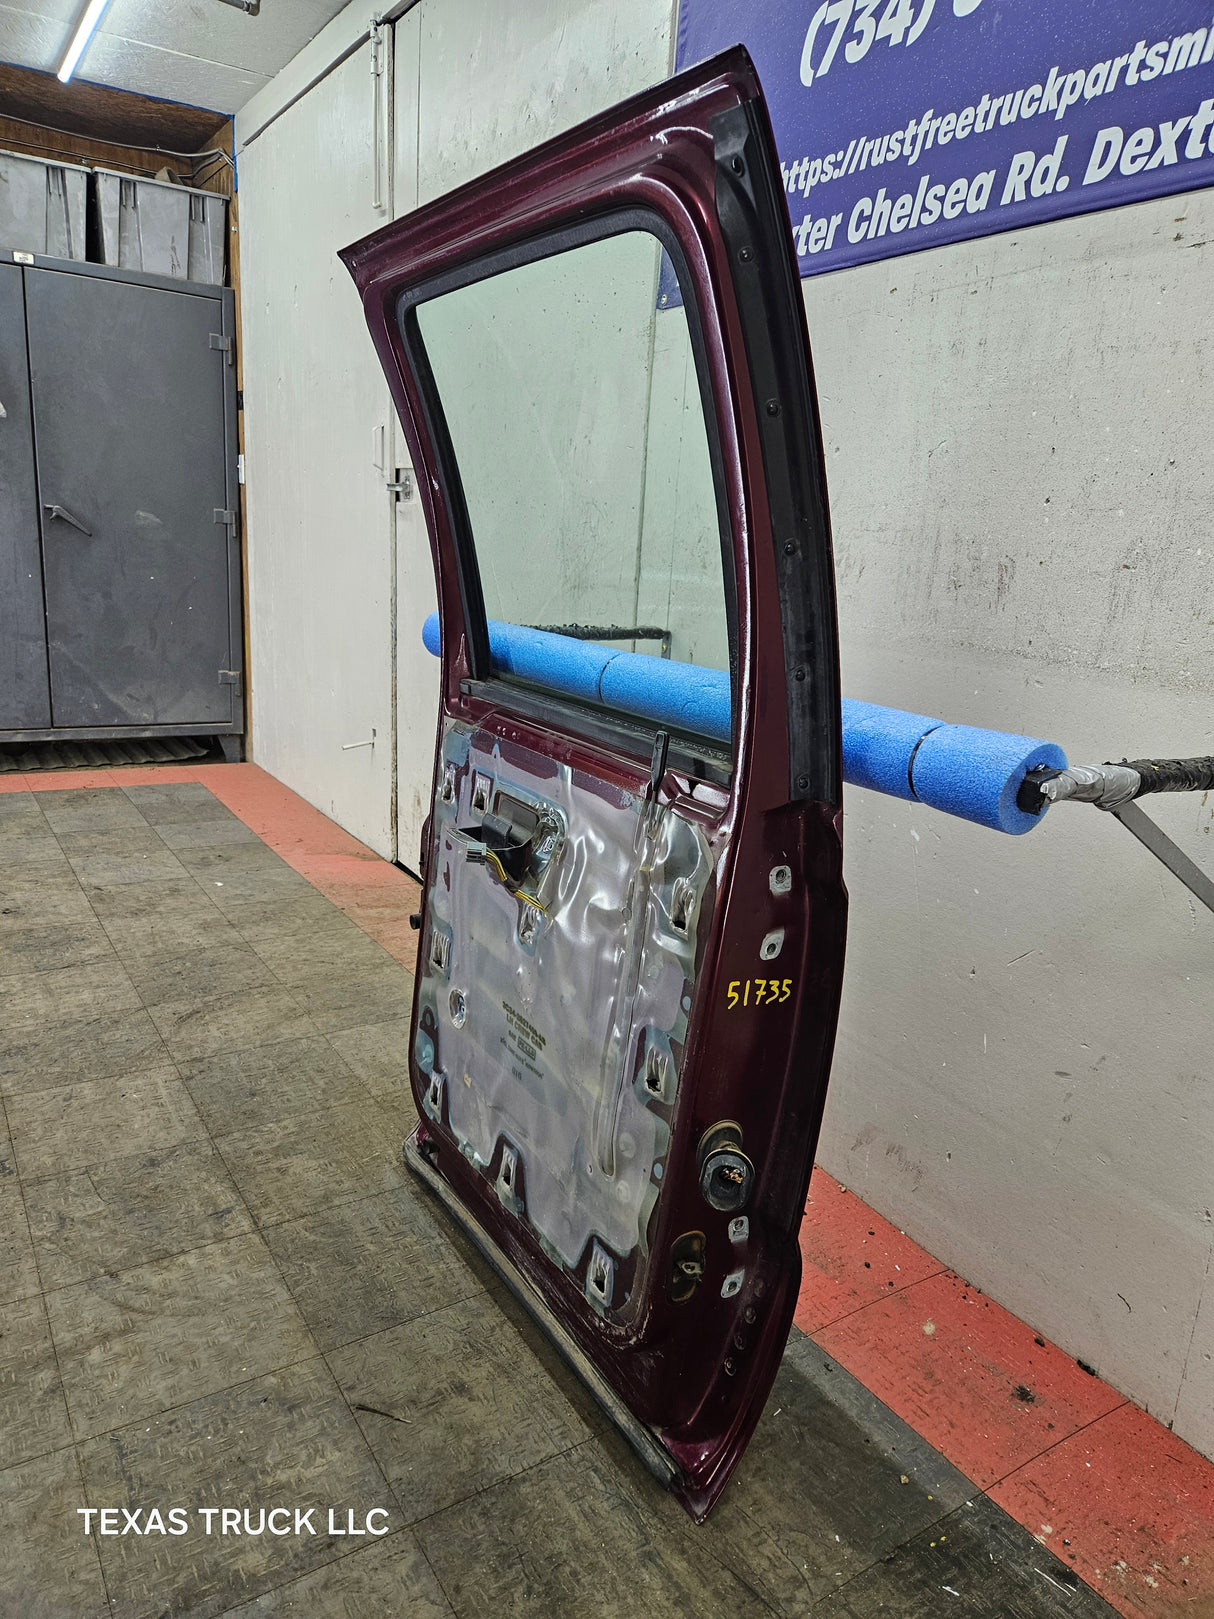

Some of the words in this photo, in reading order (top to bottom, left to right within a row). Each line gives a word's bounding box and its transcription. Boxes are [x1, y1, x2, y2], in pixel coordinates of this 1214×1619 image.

[847, 169, 996, 244] Chelsea
[1000, 134, 1070, 206] Rd.
[1082, 98, 1214, 185] Dext
[727, 979, 792, 1010] 51735
